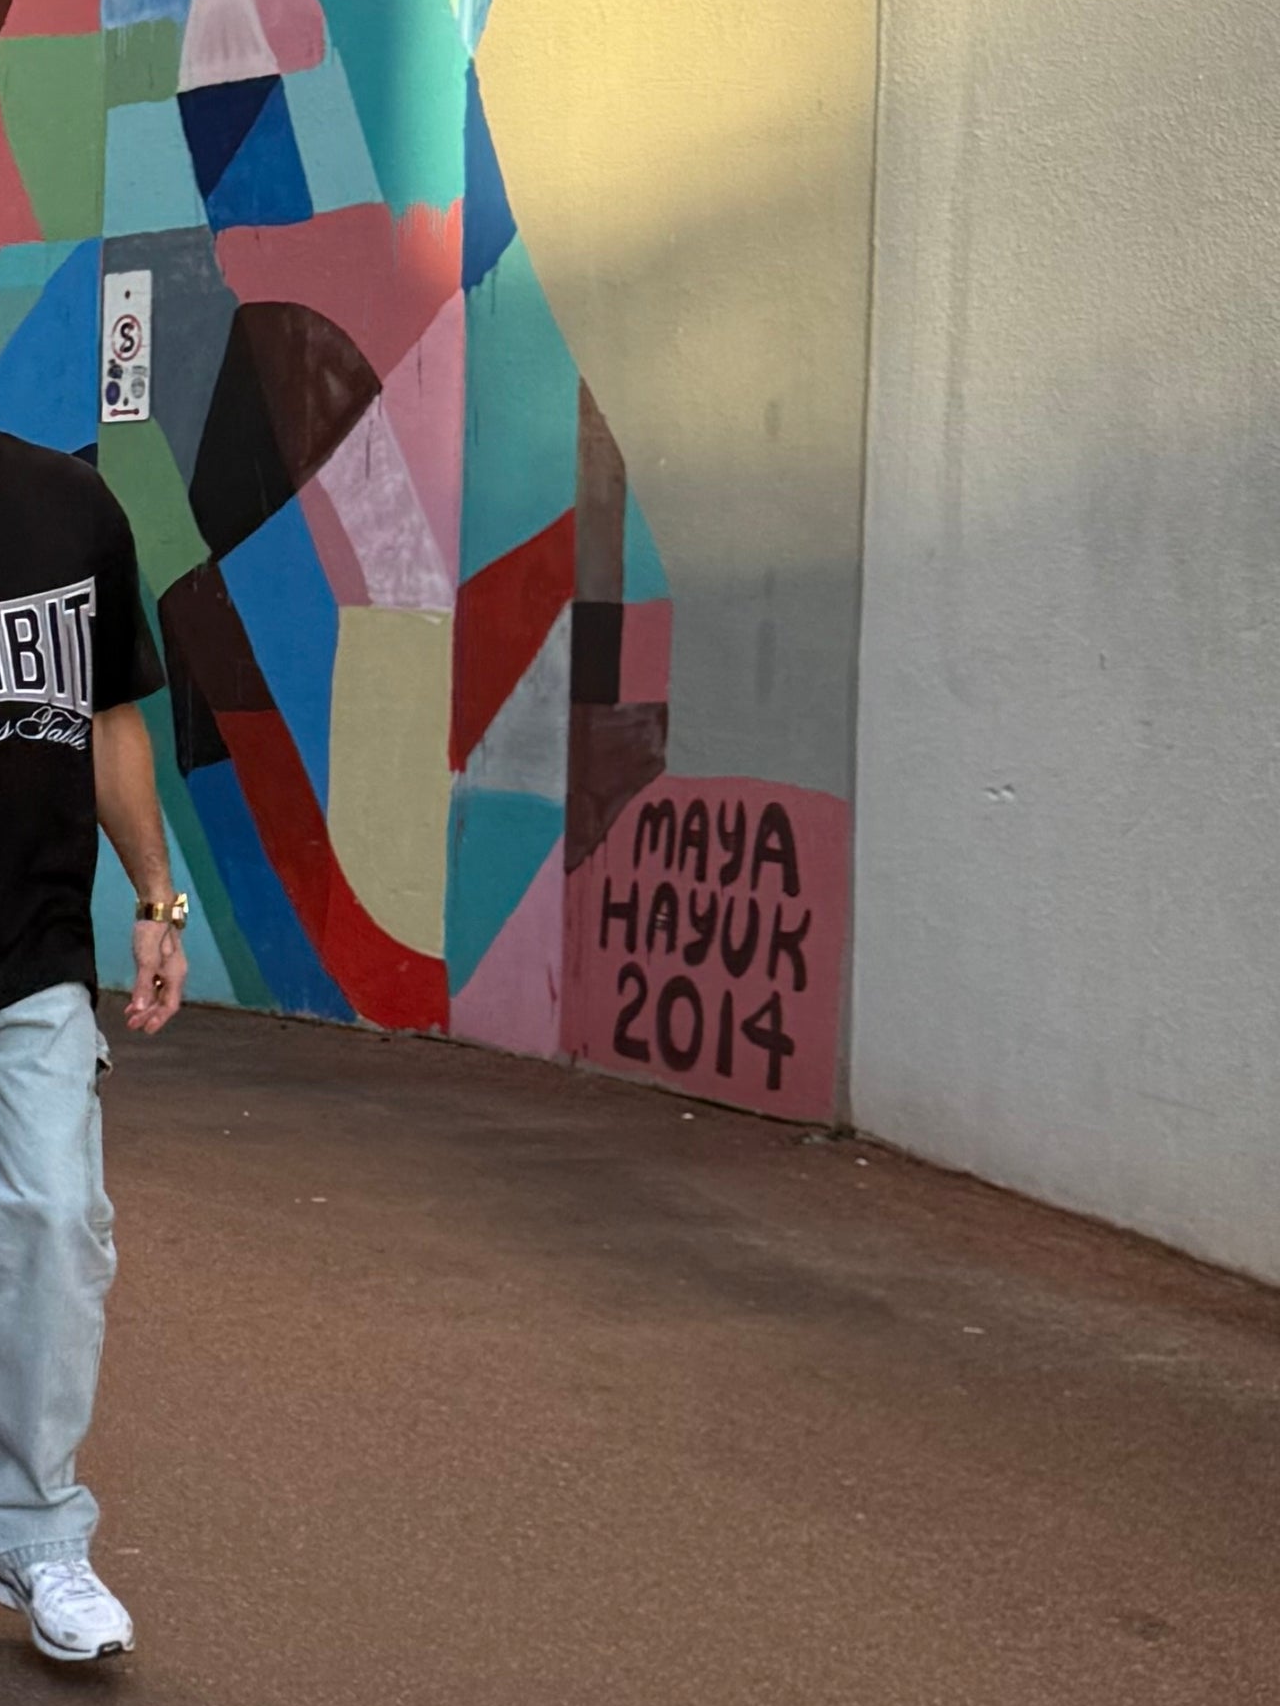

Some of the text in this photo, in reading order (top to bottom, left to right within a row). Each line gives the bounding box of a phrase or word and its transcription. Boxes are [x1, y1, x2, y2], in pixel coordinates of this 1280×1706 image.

[120, 321, 135, 354] S
[15, 705, 90, 751] Table
[633, 797, 801, 898] MAYA
[598, 876, 812, 993] HAYUK
[612, 960, 796, 1091] 2014
